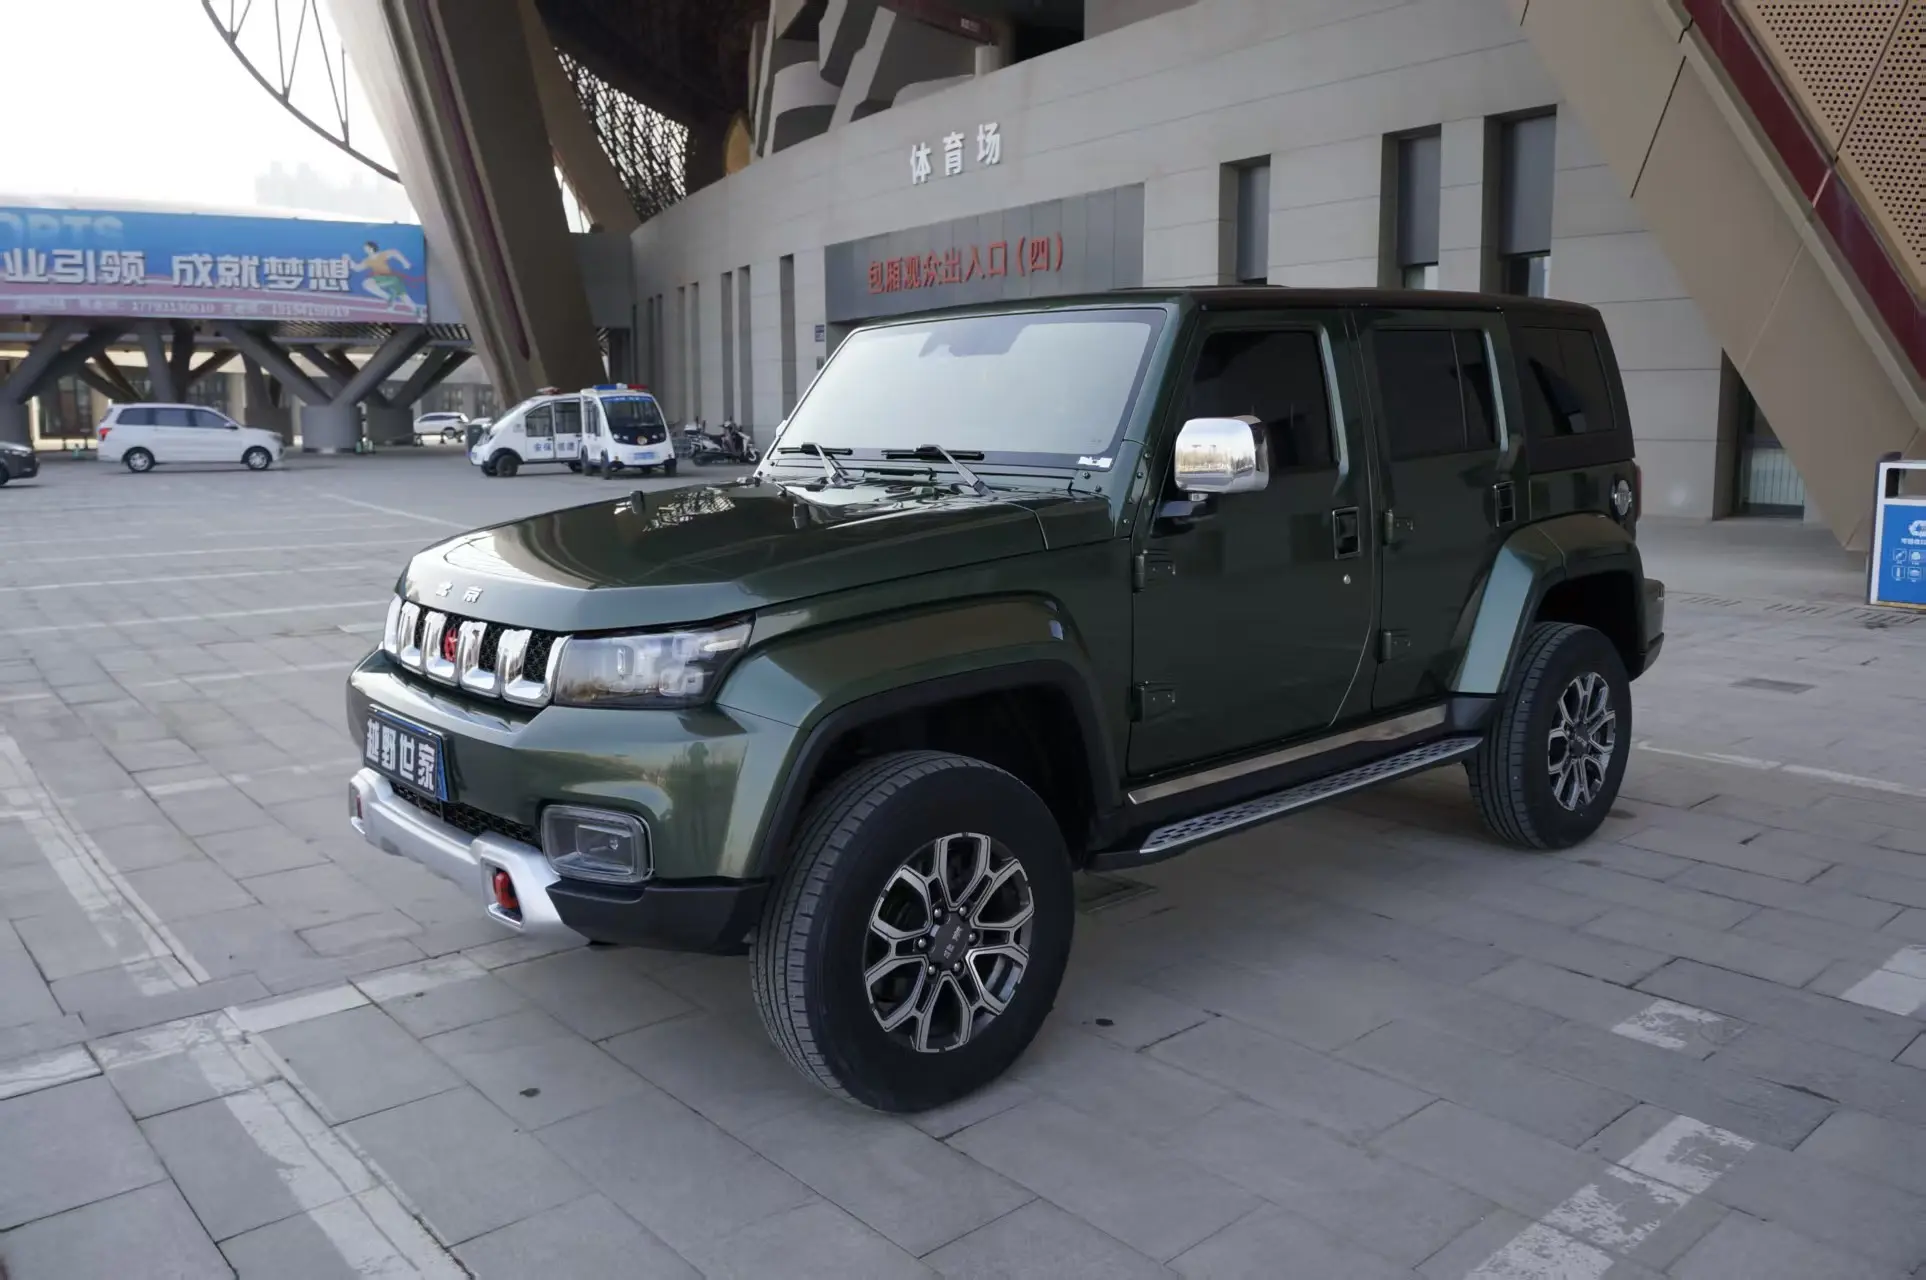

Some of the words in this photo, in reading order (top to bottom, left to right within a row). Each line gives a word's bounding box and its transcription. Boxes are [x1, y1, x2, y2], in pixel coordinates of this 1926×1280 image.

[910, 121, 1001, 185] 体育场
[171, 253, 351, 292] 成就梦想
[366, 718, 436, 792] 越野世家
